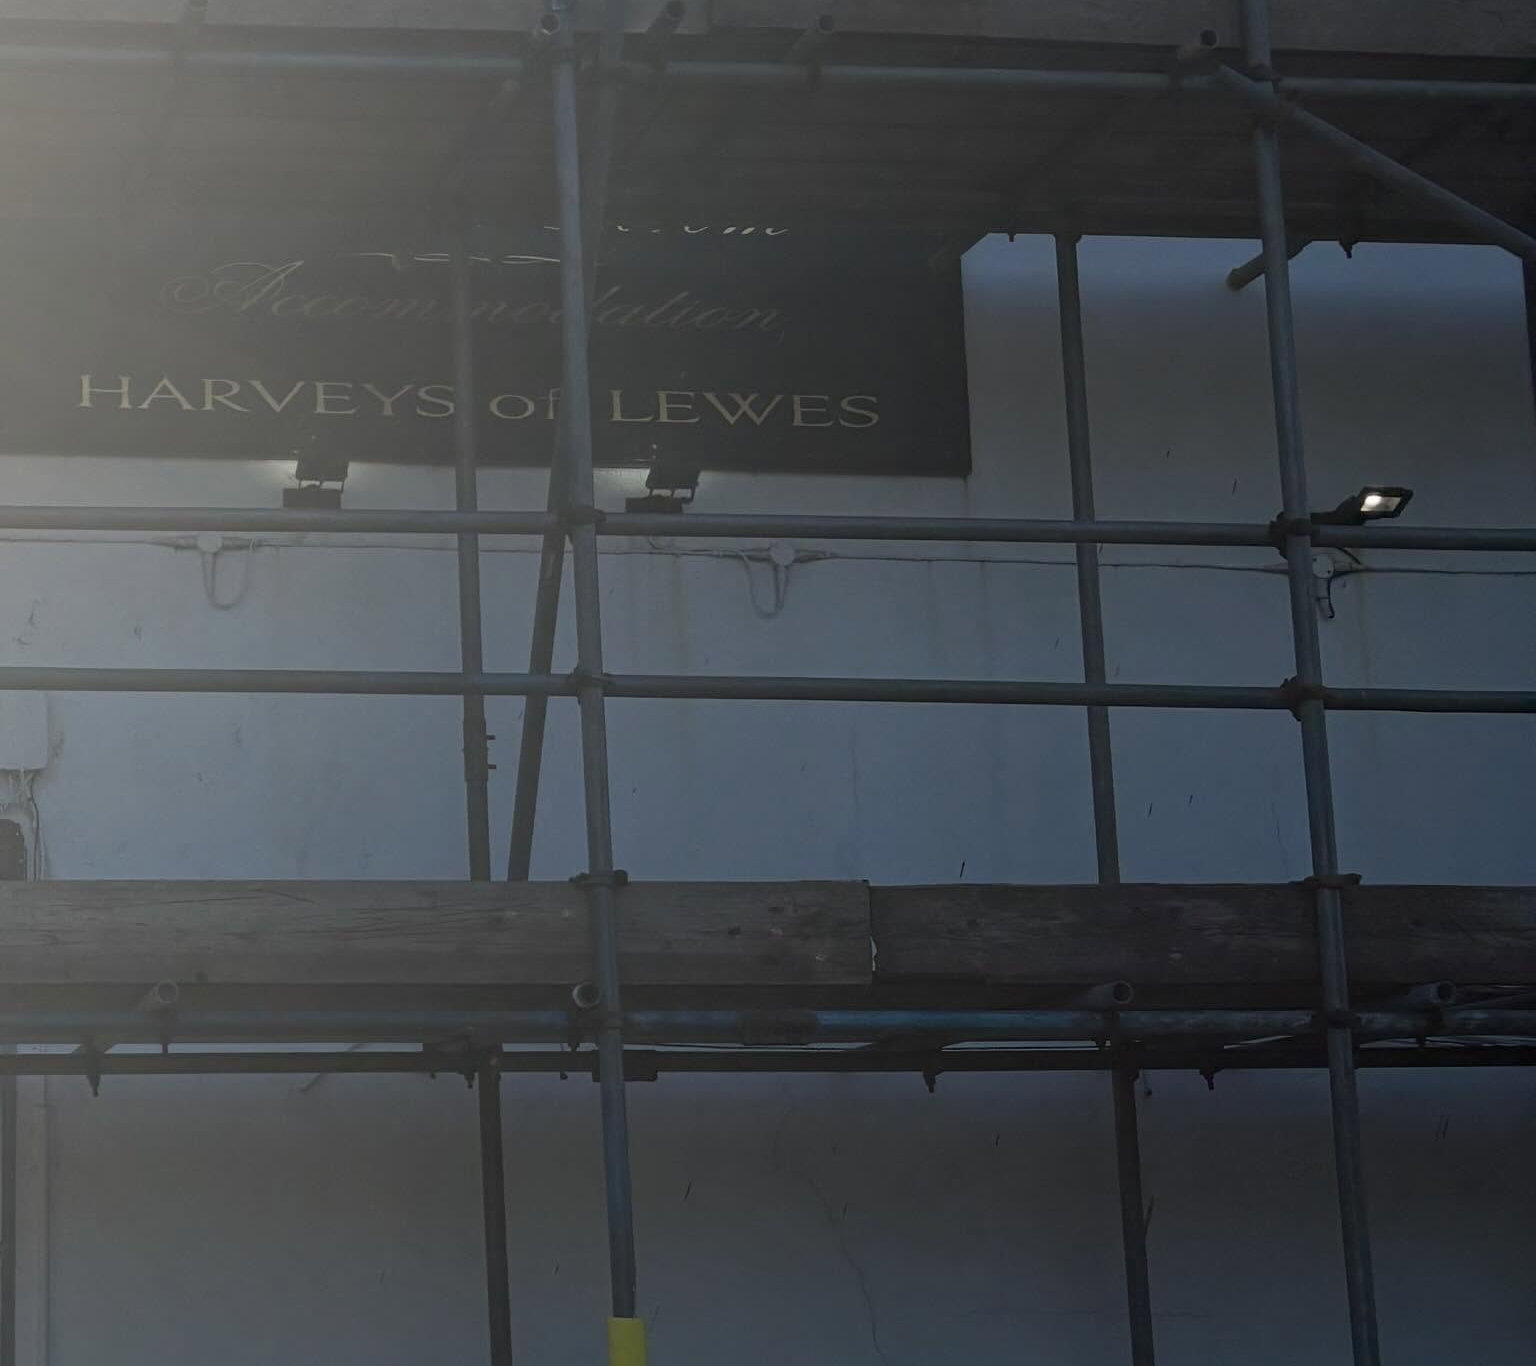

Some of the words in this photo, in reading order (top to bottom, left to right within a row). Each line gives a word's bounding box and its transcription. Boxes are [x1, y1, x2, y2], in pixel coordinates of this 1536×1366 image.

[77, 373, 457, 419] HARVEYS
[488, 386, 561, 422] of
[609, 387, 880, 429] LEWES
